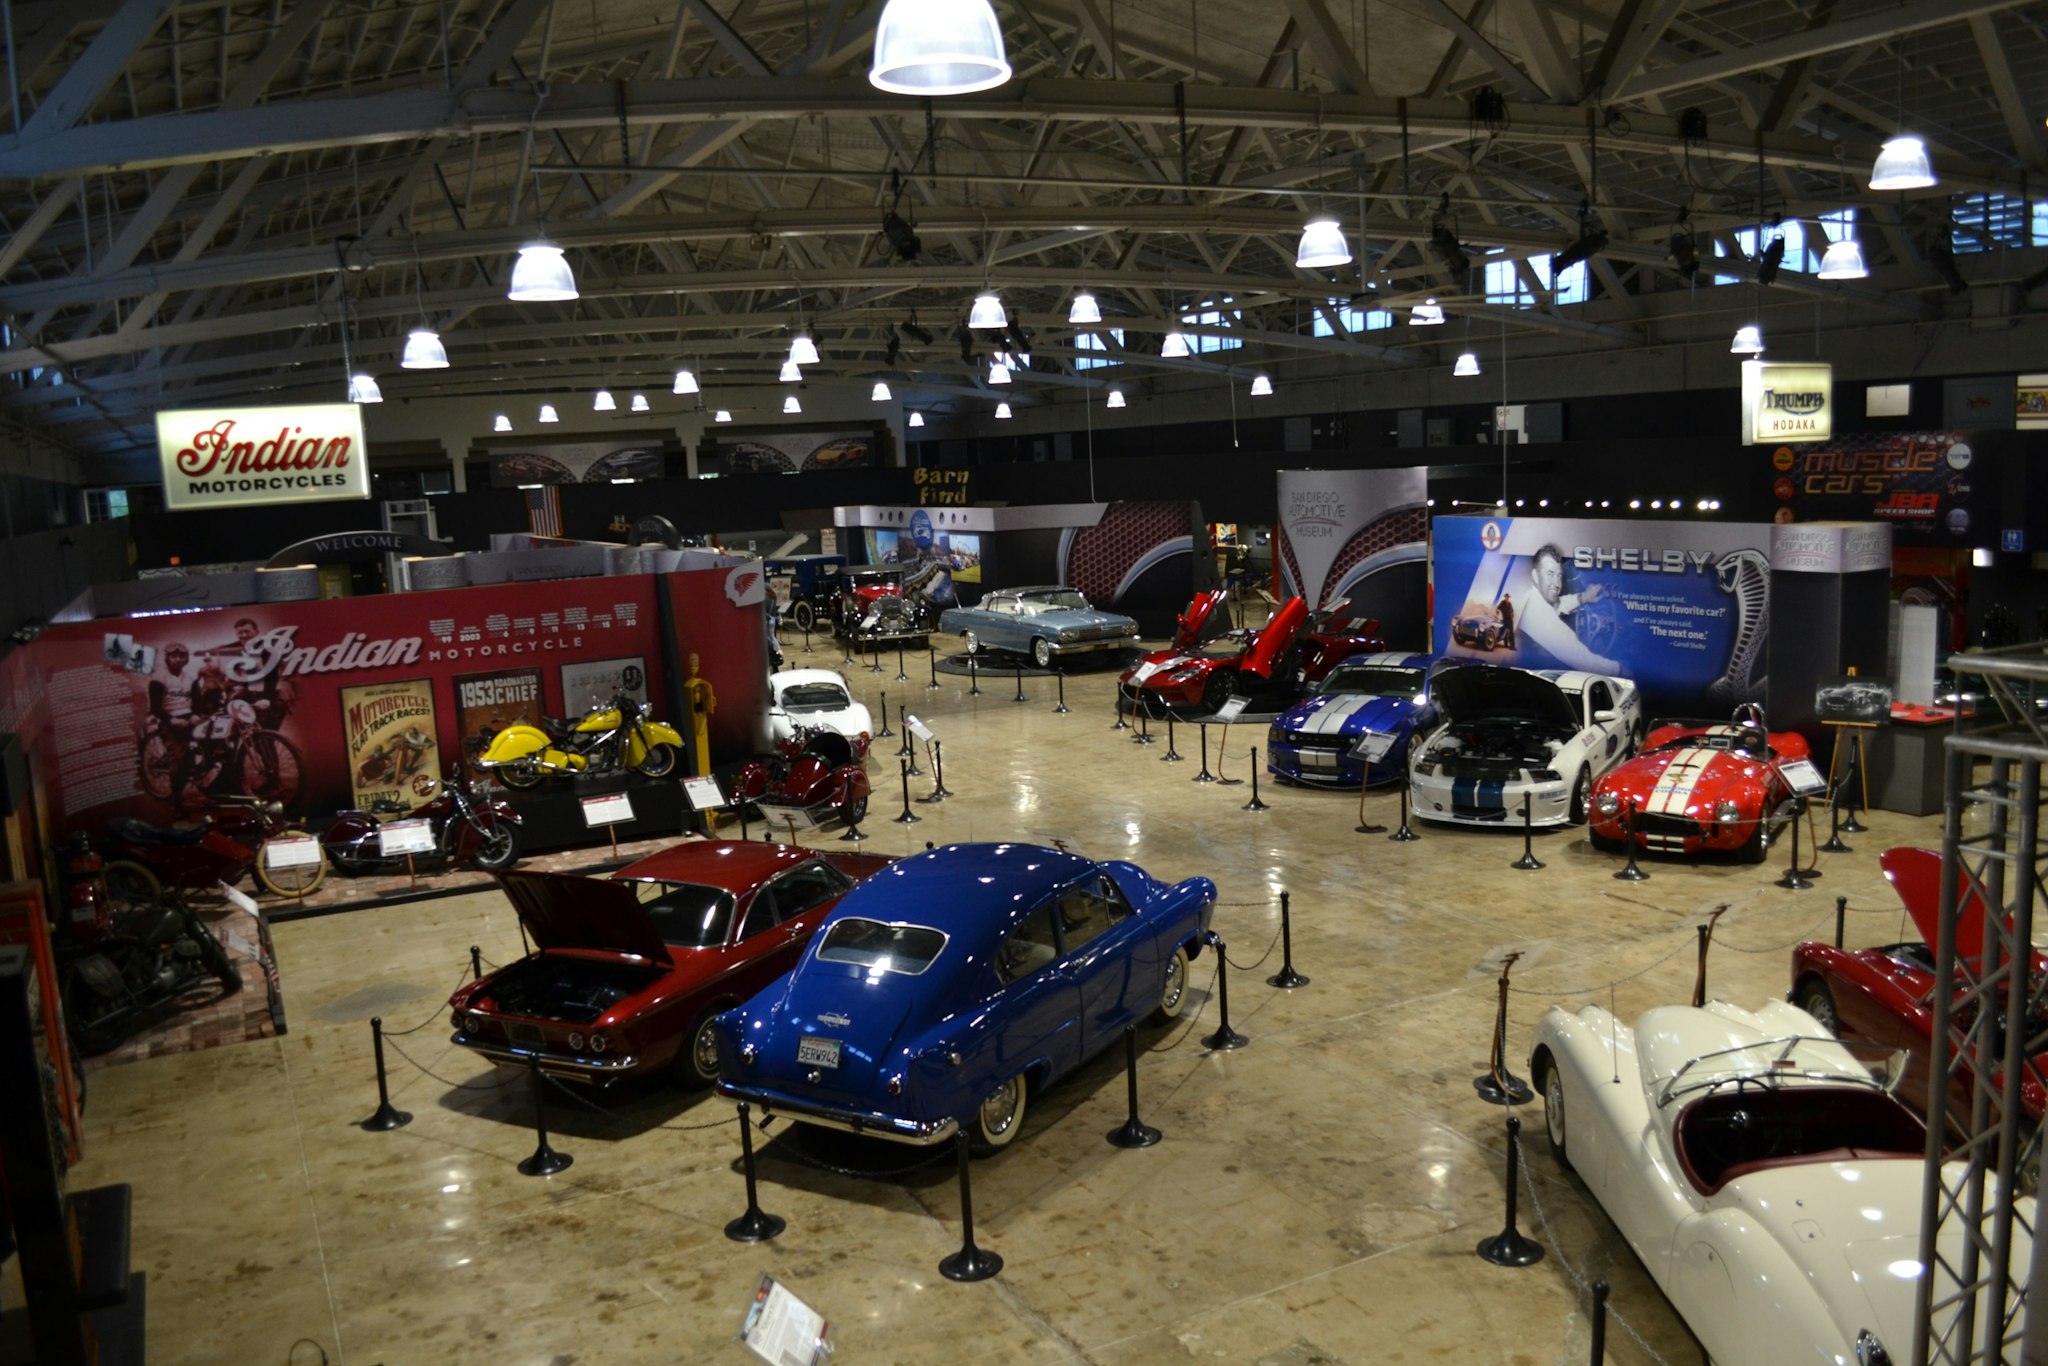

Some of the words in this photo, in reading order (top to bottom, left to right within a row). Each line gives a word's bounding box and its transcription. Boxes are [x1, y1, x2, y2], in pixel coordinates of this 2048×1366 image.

[1764, 389, 1824, 415] TRIUMPH
[1773, 419, 1816, 430] HODAKA
[176, 419, 352, 478] Indian
[1804, 441, 1937, 472] muscle
[189, 473, 347, 495] MOTORCYCLES
[913, 466, 970, 485] Barn
[1804, 474, 1891, 494] cars
[1307, 491, 1339, 503] DIEGO
[1876, 493, 1939, 508] JBA
[1296, 526, 1333, 537] MUSEUM
[314, 535, 402, 552] WELCOME
[1574, 547, 1712, 574] SHELBY
[1649, 603, 1657, 612] is
[1657, 605, 1671, 615] my
[1671, 604, 1705, 617] favorite
[1656, 618, 1678, 628] always
[459, 633, 481, 643] 2003
[1668, 630, 1687, 639] next
[225, 626, 422, 682] Indian
[429, 637, 582, 661] MOTORCYCLE
[460, 680, 495, 708] 1953
[496, 684, 538, 704] CHIEF
[348, 695, 430, 741] MOTORCYCLE
[351, 728, 369, 758] FLAT
[369, 711, 396, 736] TRACK
